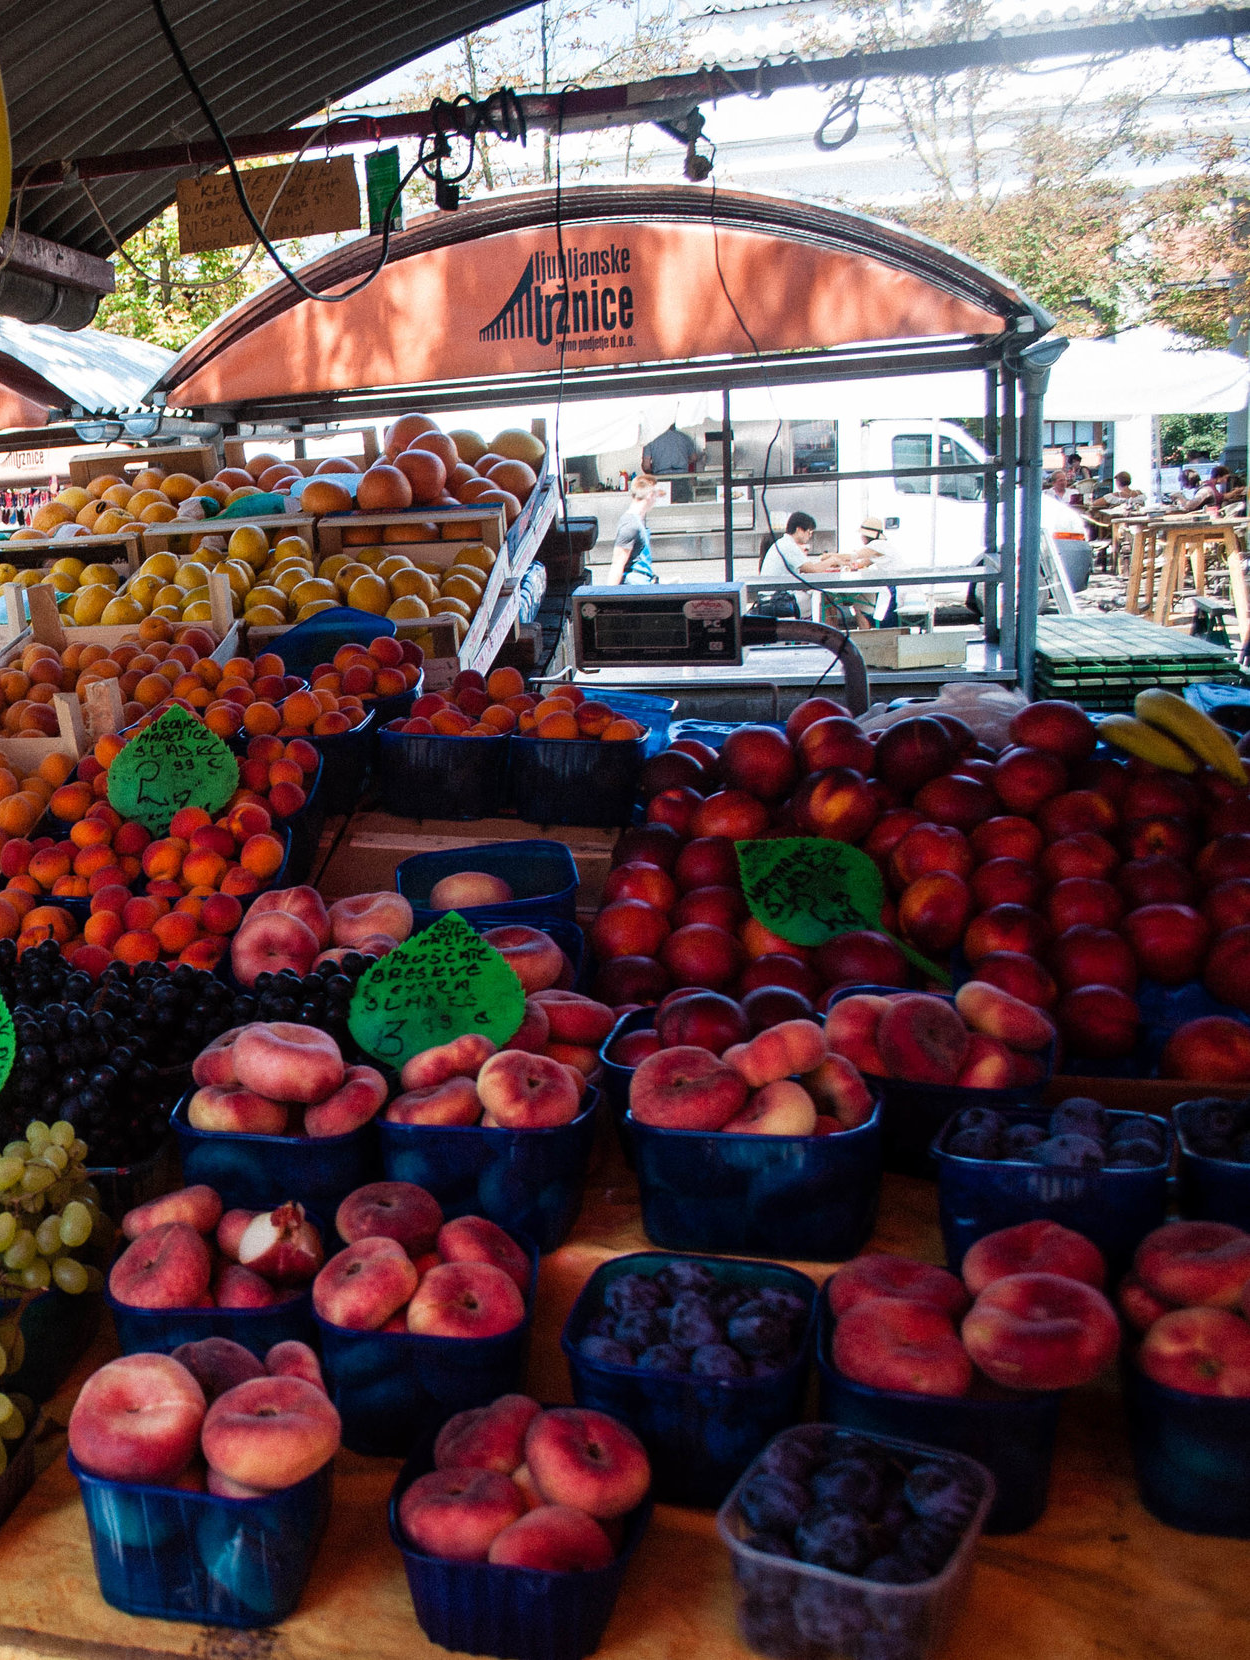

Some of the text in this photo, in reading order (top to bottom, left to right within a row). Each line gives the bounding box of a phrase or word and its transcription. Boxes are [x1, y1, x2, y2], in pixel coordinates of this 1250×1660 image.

[535, 244, 630, 285] ljubljanske
[534, 279, 634, 346] tržnice
[610, 333, 636, 349] d.o.o.
[370, 962, 483, 984] BRESKVE
